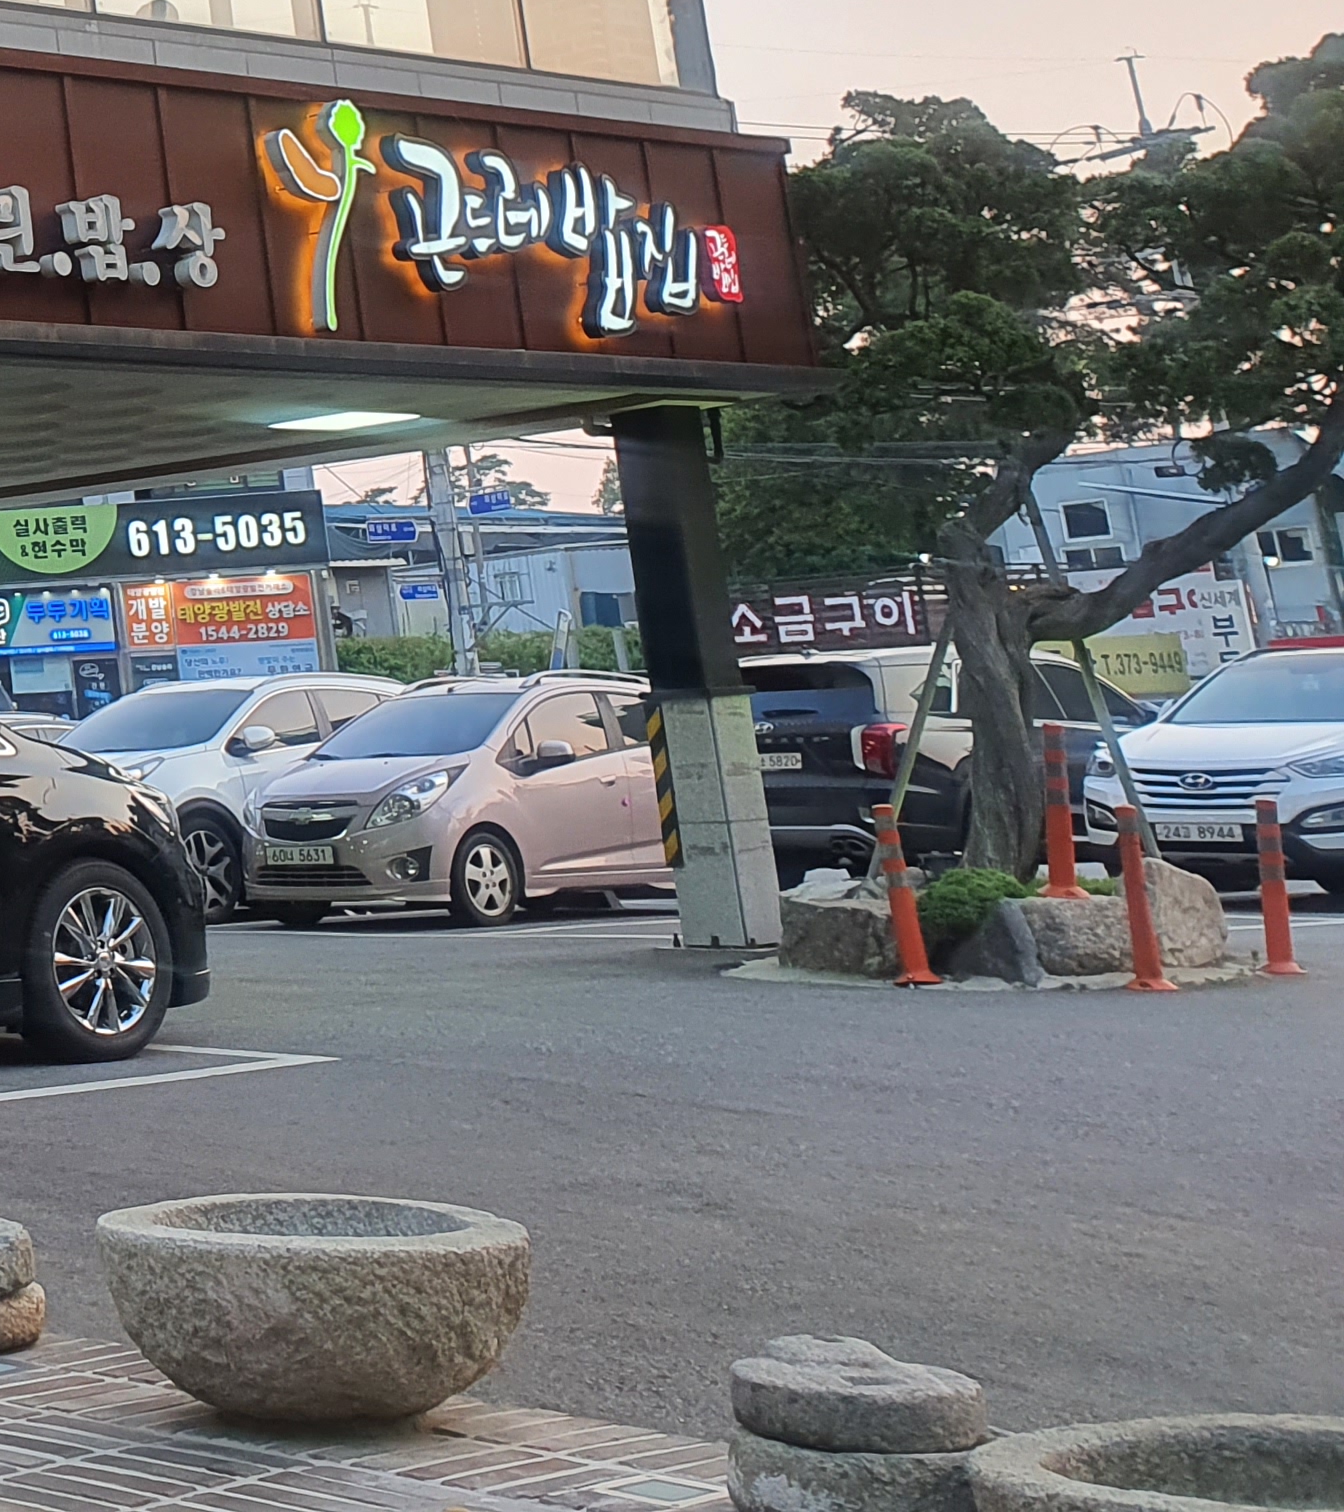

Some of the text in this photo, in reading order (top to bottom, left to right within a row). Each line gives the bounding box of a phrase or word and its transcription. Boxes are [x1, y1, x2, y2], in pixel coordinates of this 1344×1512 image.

[392, 136, 700, 332] 곤드레밥집
[13, 515, 89, 538] 실사출력
[127, 510, 307, 559] 613-5035
[128, 598, 167, 620] 개발
[177, 600, 311, 624] 태양광발전 상담소
[731, 591, 916, 644] 소금구이
[130, 621, 170, 644] 분양
[199, 622, 290, 641] 1544-2829
[1197, 825, 1236, 839] 8944
[299, 849, 326, 862] 5631
